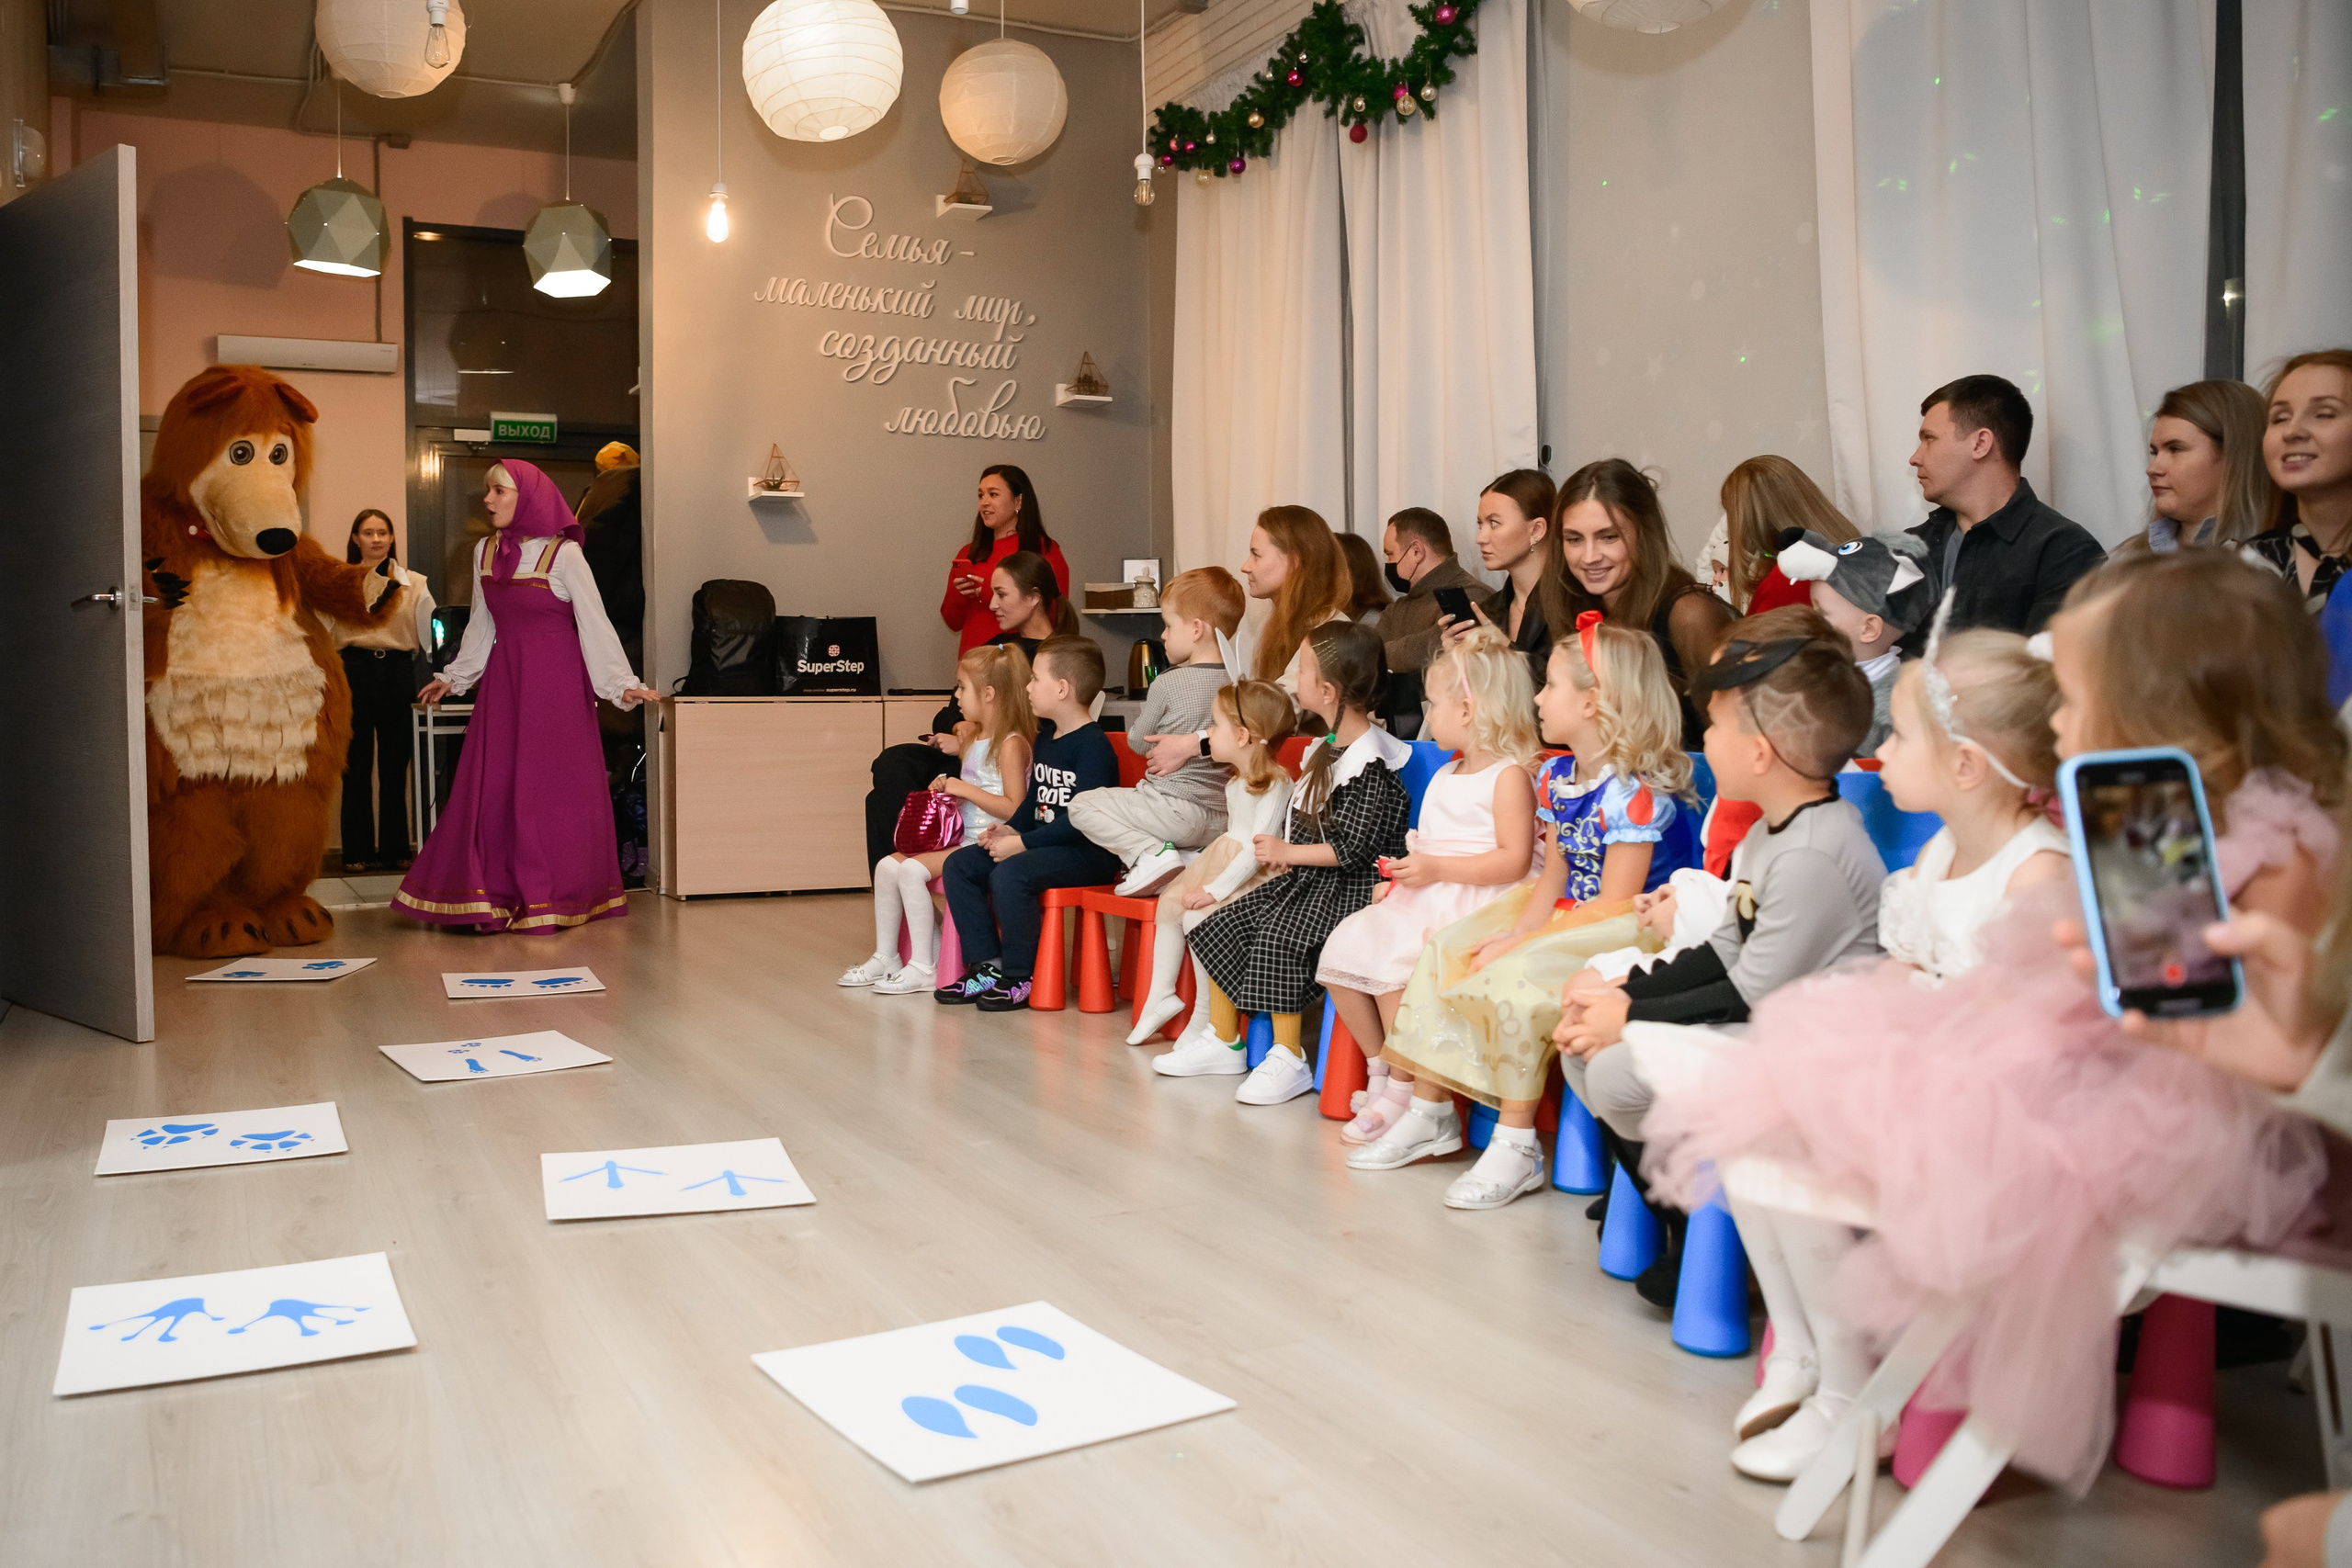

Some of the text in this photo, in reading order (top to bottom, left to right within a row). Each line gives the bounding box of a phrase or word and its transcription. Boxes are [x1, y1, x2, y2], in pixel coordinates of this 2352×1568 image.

[826, 192, 951, 265] Семья
[754, 276, 1036, 341] маленький мир,
[820, 329, 1023, 385] созданный
[498, 423, 550, 439] ВЫХОД
[885, 377, 1046, 440] любовью
[797, 659, 865, 675] SuperStep
